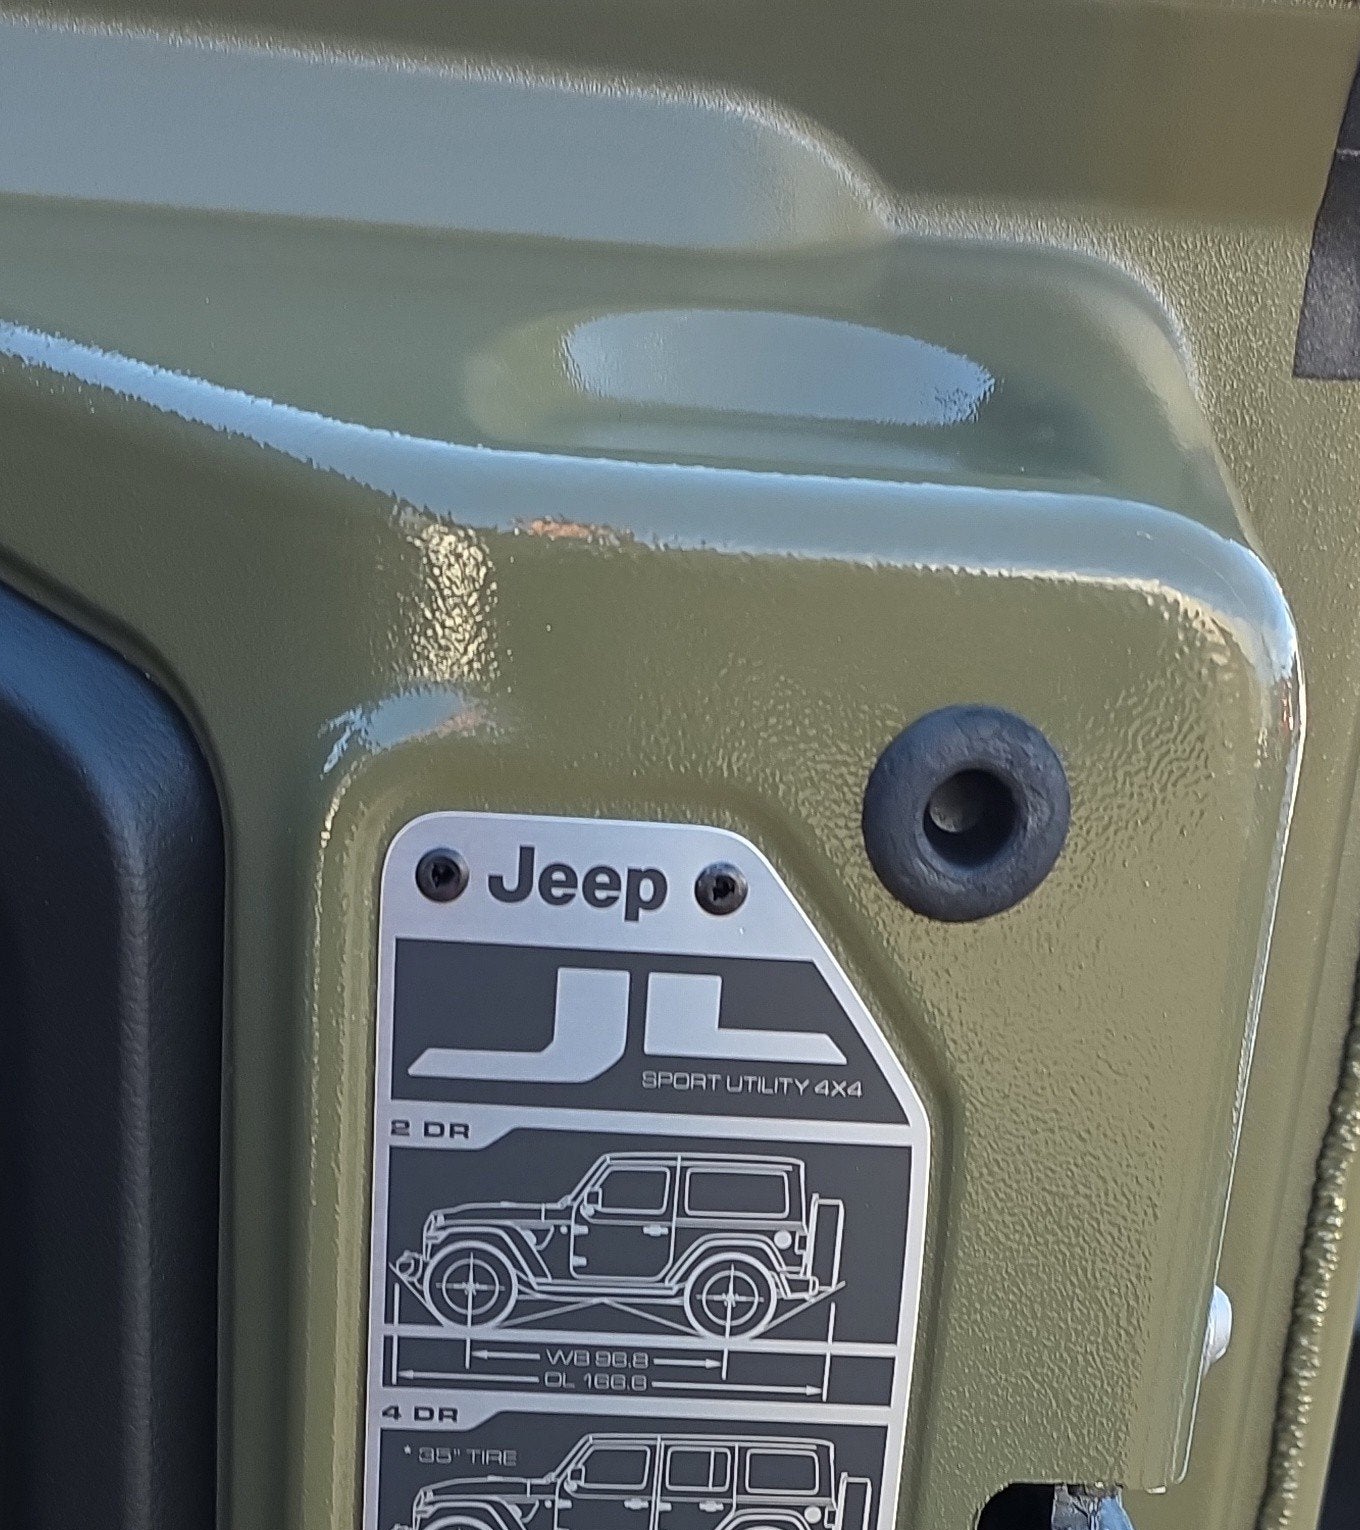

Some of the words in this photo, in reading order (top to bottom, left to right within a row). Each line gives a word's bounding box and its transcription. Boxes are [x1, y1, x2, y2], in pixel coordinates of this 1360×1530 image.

[488, 845, 668, 922] Jeep
[408, 967, 847, 1084] JL
[642, 1070, 722, 1091] SPORT
[726, 1074, 810, 1096] UTILITY
[814, 1079, 863, 1098] 4X4
[390, 1119, 410, 1136] 2
[423, 1120, 469, 1139] DR
[546, 1348, 590, 1367] WB
[544, 1371, 575, 1389] OL
[381, 1405, 402, 1421] 4
[413, 1405, 459, 1422] DR
[466, 1448, 517, 1467] TIRE
